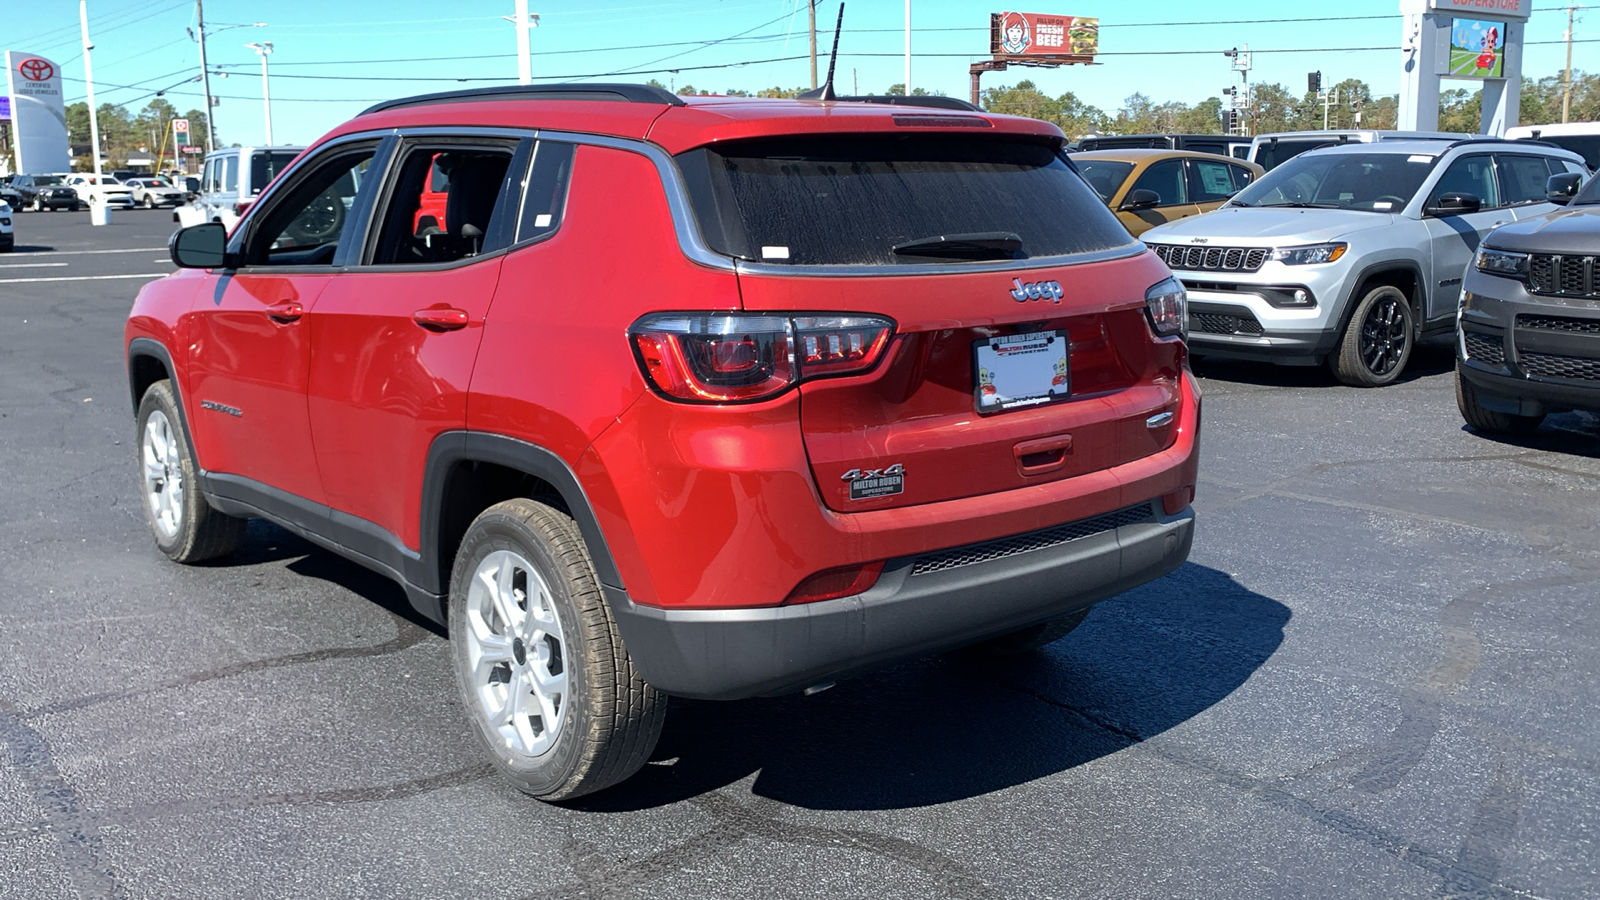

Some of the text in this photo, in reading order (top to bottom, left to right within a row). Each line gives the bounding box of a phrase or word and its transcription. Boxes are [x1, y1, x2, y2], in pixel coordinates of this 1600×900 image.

[1036, 24, 1064, 35] FRESH
[1036, 33, 1064, 47] BEEF
[1009, 277, 1064, 304] Jeep
[1022, 342, 1049, 350] RUBEN
[853, 475, 901, 490] MILTON RUBEN
[861, 485, 894, 495] SUPERSTORE
